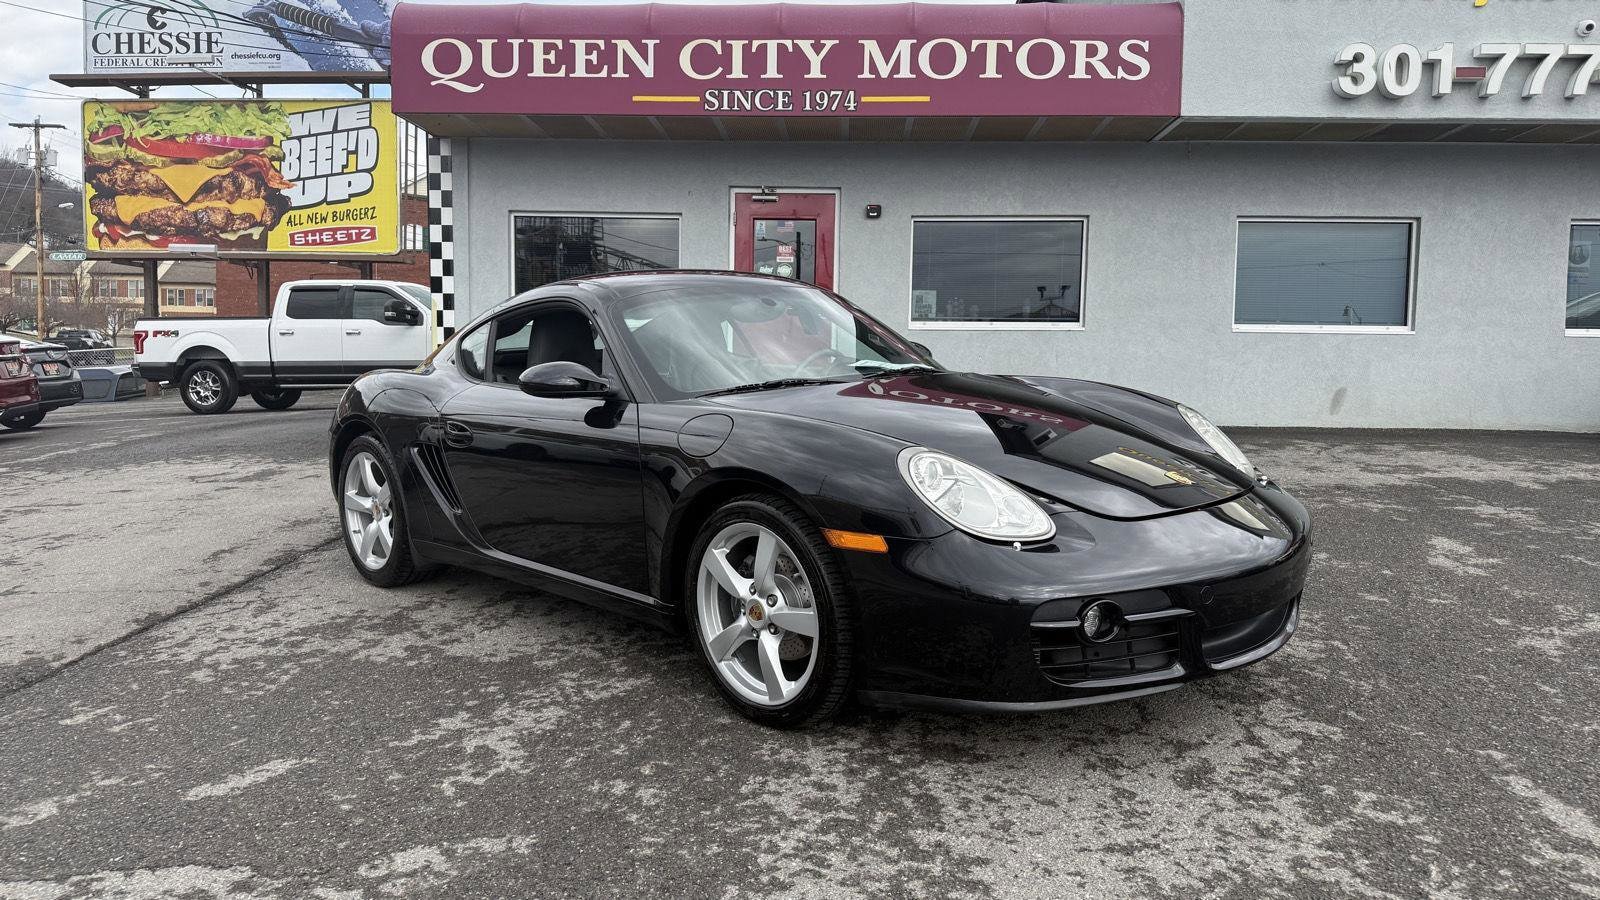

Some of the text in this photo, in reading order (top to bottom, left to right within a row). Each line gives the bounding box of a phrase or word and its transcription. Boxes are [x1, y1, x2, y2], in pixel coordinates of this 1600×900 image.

[91, 31, 224, 55] CHESSIE
[93, 57, 141, 67] FEDERAL
[144, 57, 184, 67] CRE
[230, 51, 281, 61] chessiefcu.org
[421, 37, 1151, 93] QUEEN CITY MOTORS
[704, 89, 858, 112] SINCE 1974
[287, 101, 372, 138] WE
[280, 127, 379, 181] BEEF'D
[281, 172, 374, 209] UP
[286, 206, 378, 227] ALL NEW BURGERZ
[294, 229, 372, 245] SHEETZ
[52, 252, 84, 261] LAMAR
[153, 330, 179, 338] FX4
